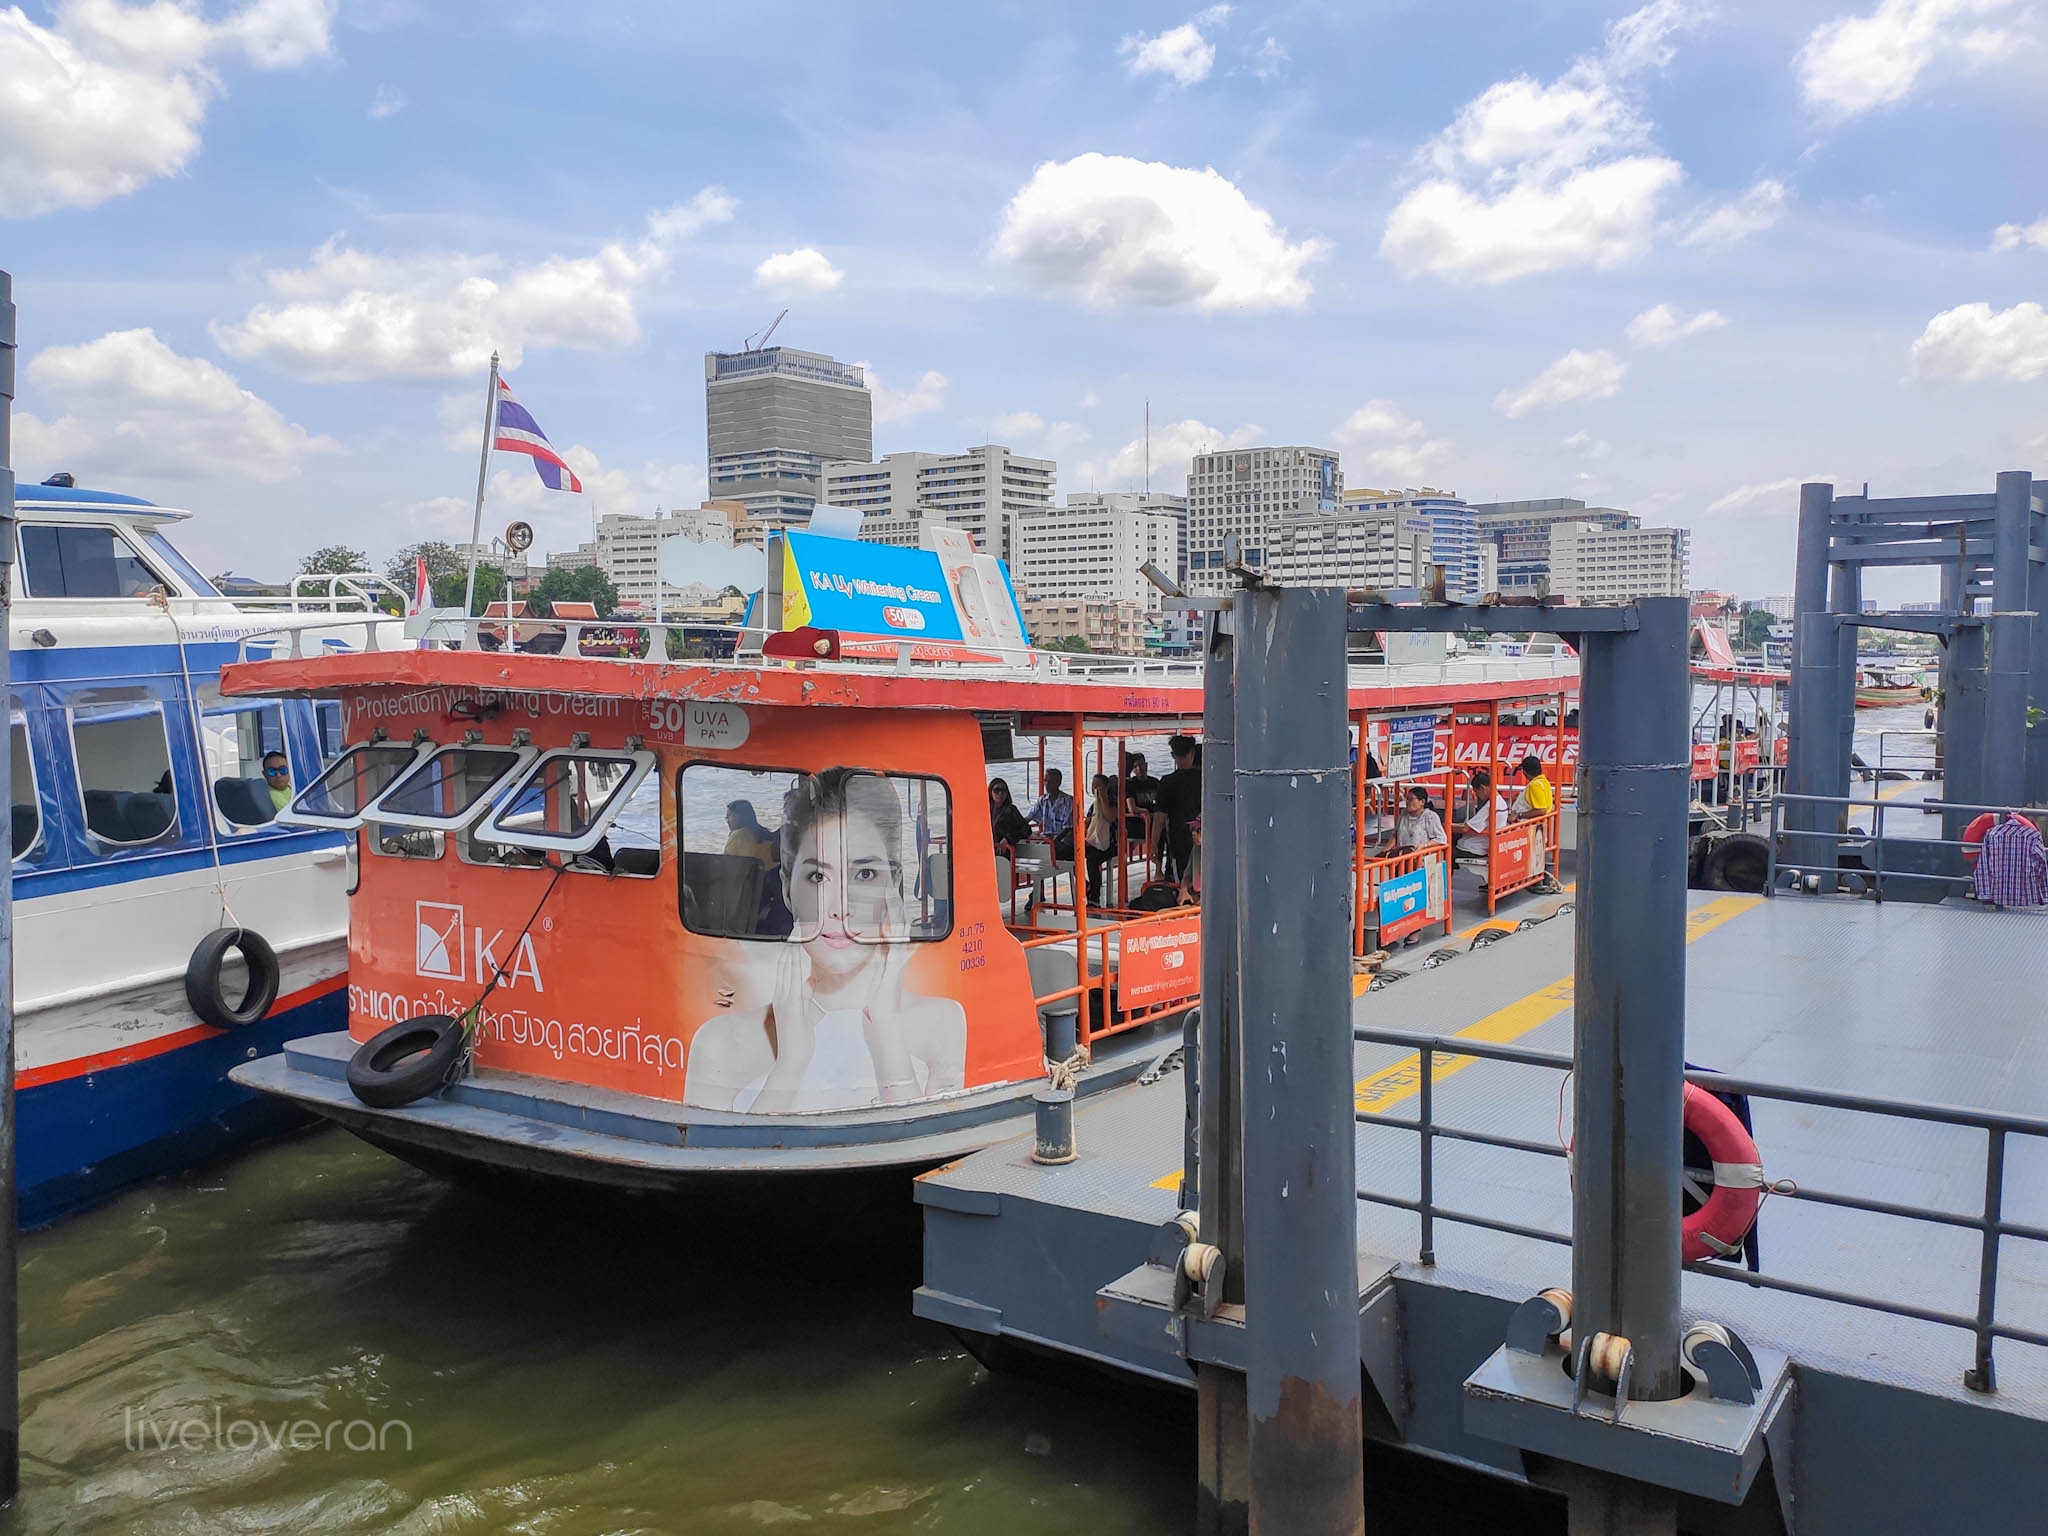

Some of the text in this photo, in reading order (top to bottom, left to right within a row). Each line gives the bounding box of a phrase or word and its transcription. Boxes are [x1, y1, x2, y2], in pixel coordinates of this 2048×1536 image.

[810, 571, 834, 591] KA
[852, 578, 907, 602] Whitening
[905, 585, 942, 603] Cream
[889, 608, 904, 622] 50
[354, 689, 442, 720] Protection
[546, 693, 619, 717] Cream
[650, 700, 684, 732] 50
[694, 710, 729, 726] UVA
[657, 731, 674, 740] UVB
[962, 938, 983, 953] 4210
[474, 927, 544, 993] KA
[960, 955, 985, 971] 00336
